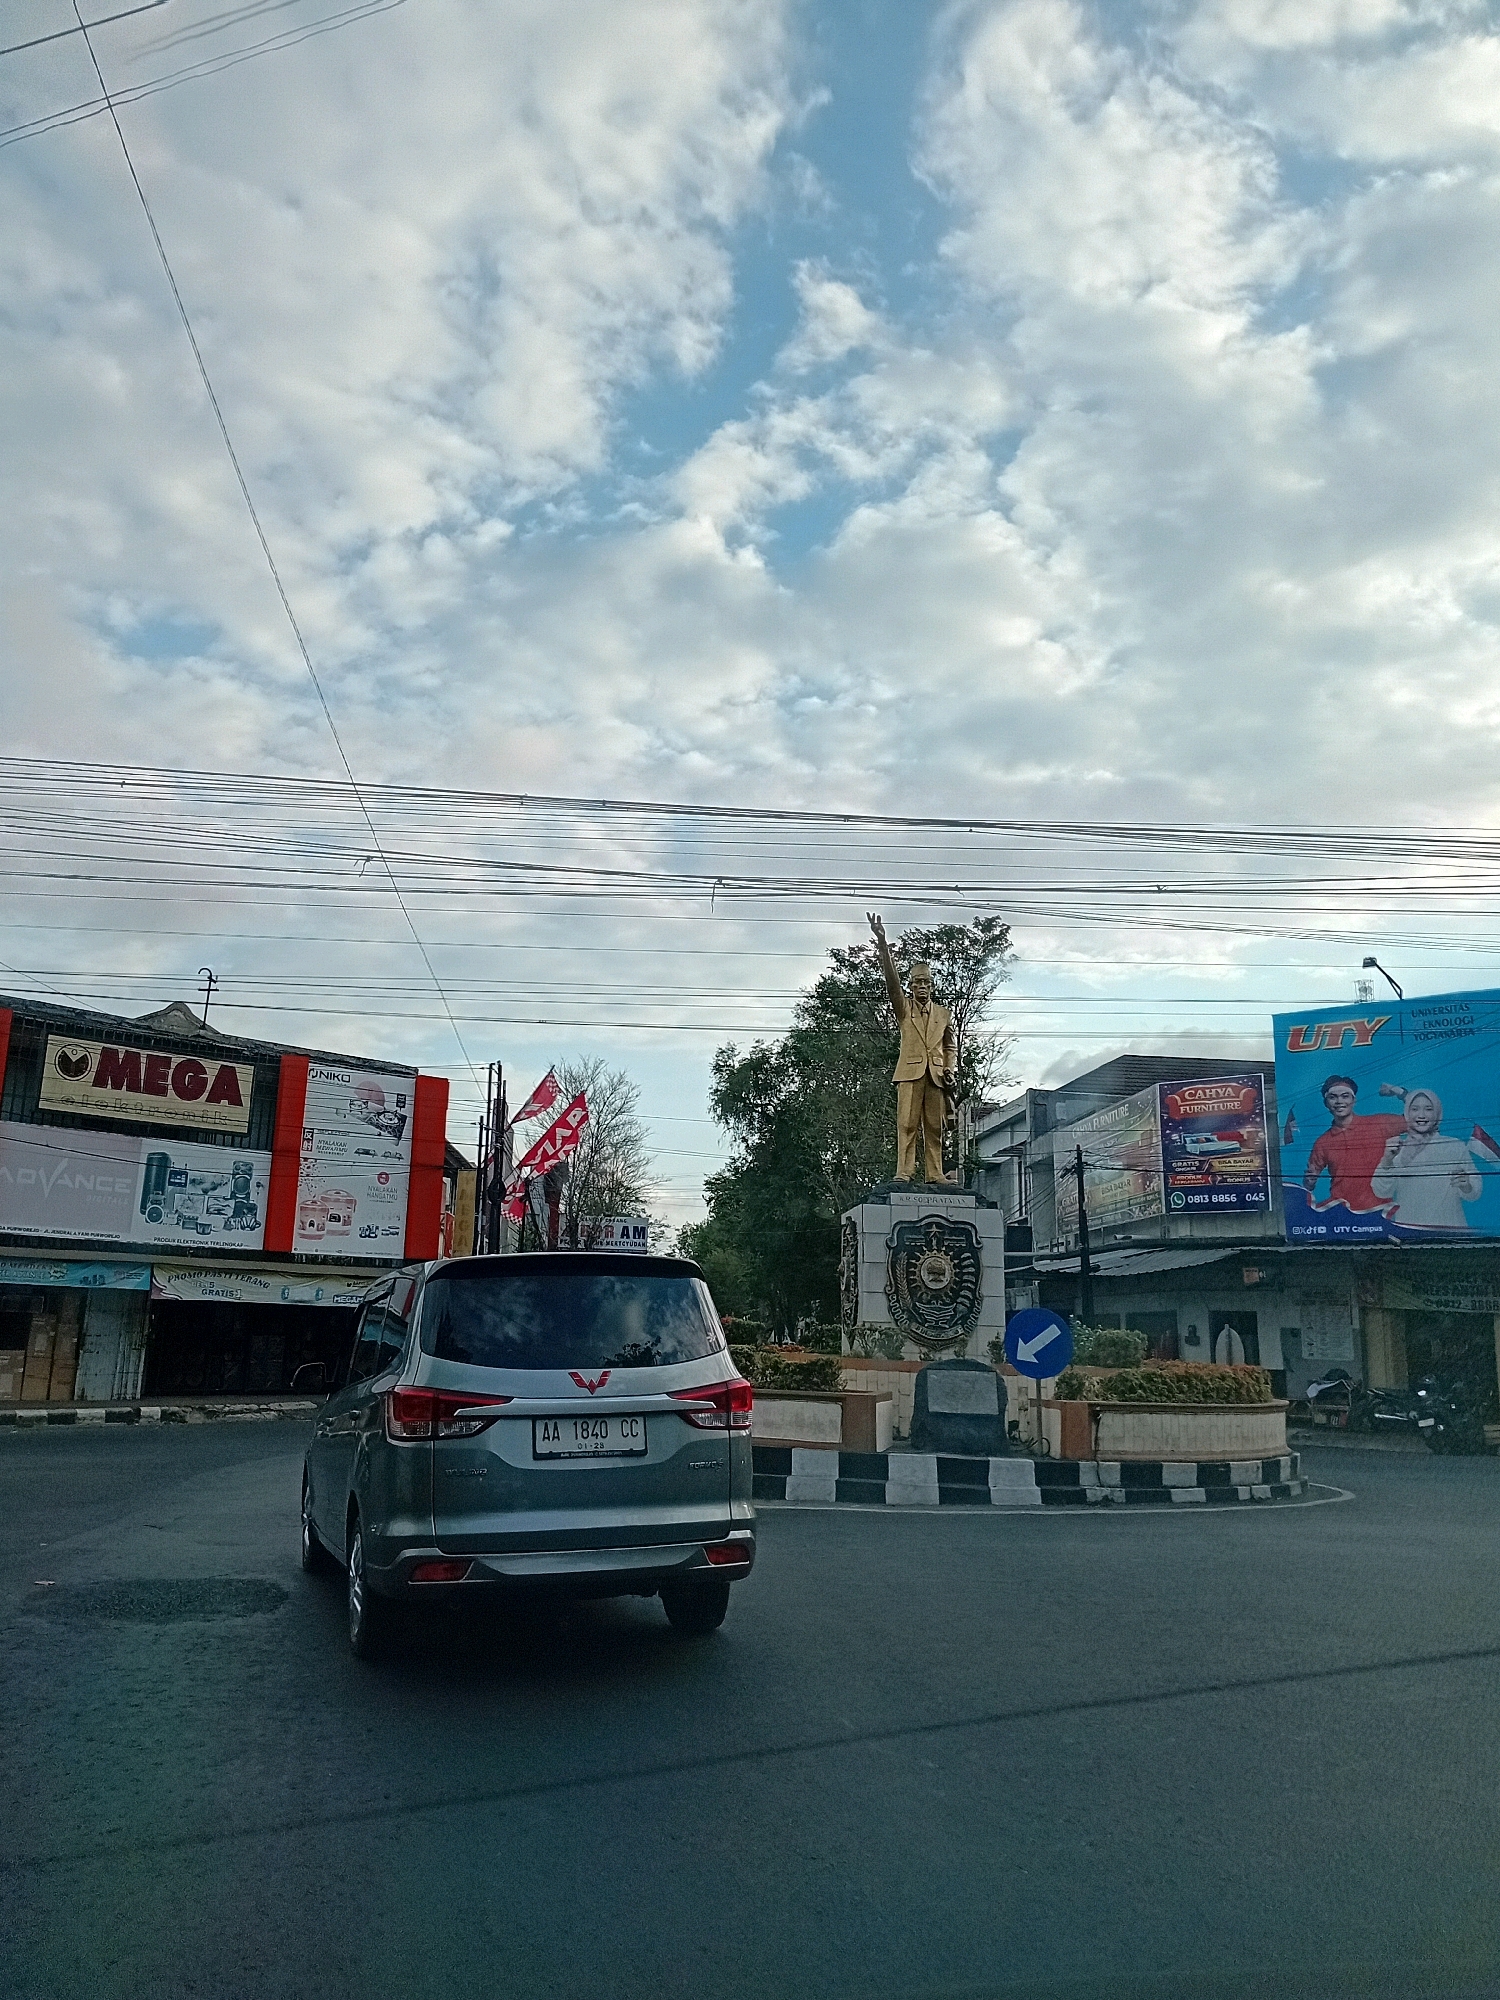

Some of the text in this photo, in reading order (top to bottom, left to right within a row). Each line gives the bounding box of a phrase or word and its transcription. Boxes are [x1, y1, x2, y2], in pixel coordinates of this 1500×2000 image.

[1411, 1003, 1470, 1018] UNIVERSITAS
[1423, 1015, 1475, 1029] EKNOLOGI
[1286, 1015, 1392, 1053] UTY
[1413, 1027, 1476, 1041] YOGYAKARTA
[92, 1046, 243, 1107] MEGA
[1184, 1087, 1236, 1100] CAHYA
[59, 1093, 228, 1126] elektronik
[1180, 1101, 1241, 1114] FURNITURE
[1093, 1104, 1129, 1130] FURNITURE
[1172, 1160, 1200, 1168] GRATIS
[367, 1185, 398, 1194] NYALAKAN
[366, 1192, 398, 1201] HANGATMU
[1187, 1192, 1266, 1204] 0813 8856 045
[620, 1226, 647, 1240] AM
[1351, 1225, 1383, 1234] Campus
[153, 1236, 176, 1244] PRODUK
[209, 1240, 243, 1248] TERLENGKAP
[167, 1270, 271, 1290] PROMO PASTI TERANG
[208, 1281, 215, 1289] 5
[201, 1288, 235, 1298] GRATIS
[541, 1418, 639, 1442] AA 1840 CC
